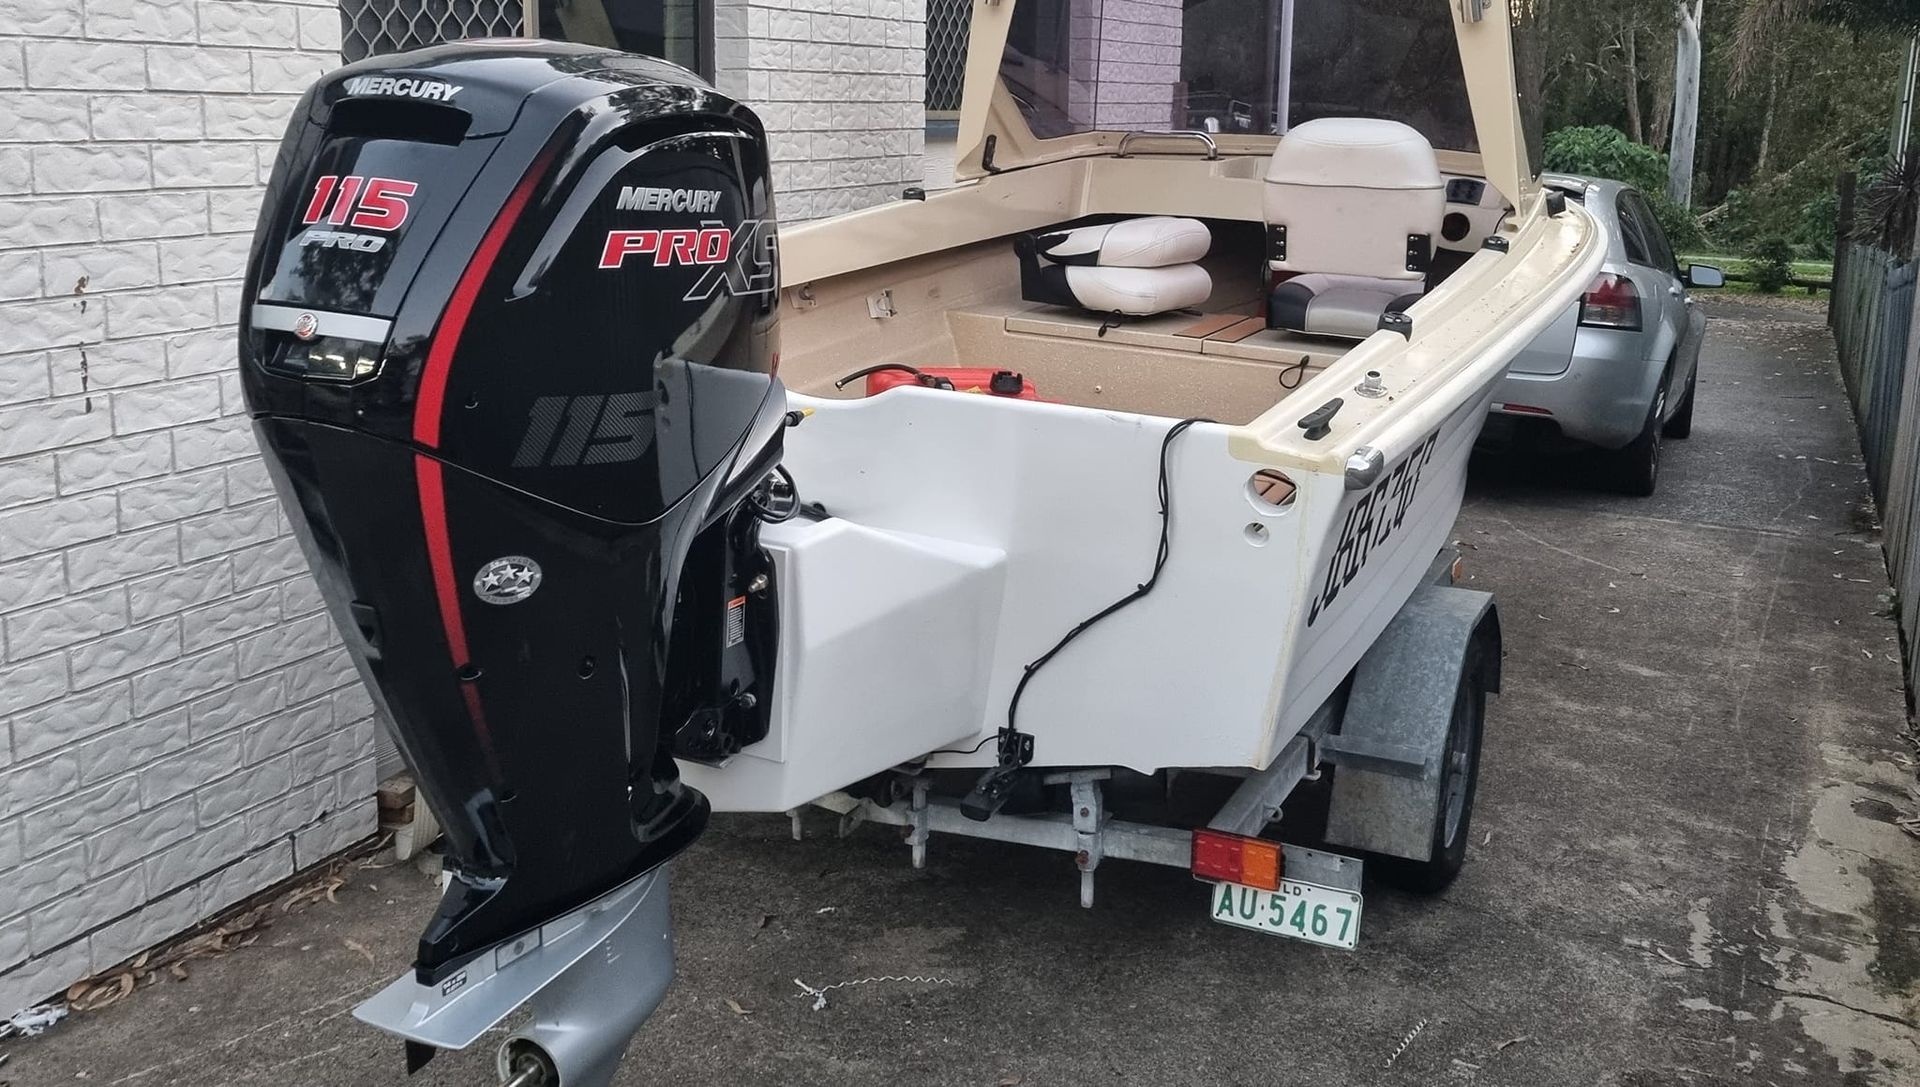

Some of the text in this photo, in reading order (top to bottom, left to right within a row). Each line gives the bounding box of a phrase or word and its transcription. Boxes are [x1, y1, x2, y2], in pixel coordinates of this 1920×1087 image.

[346, 77, 464, 101] MERCURY
[302, 175, 418, 232] 115
[616, 186, 722, 213] MERCURY
[298, 230, 387, 253] PRO
[598, 228, 731, 269] PRO
[511, 390, 663, 468] 115
[1282, 883, 1302, 897] LD
